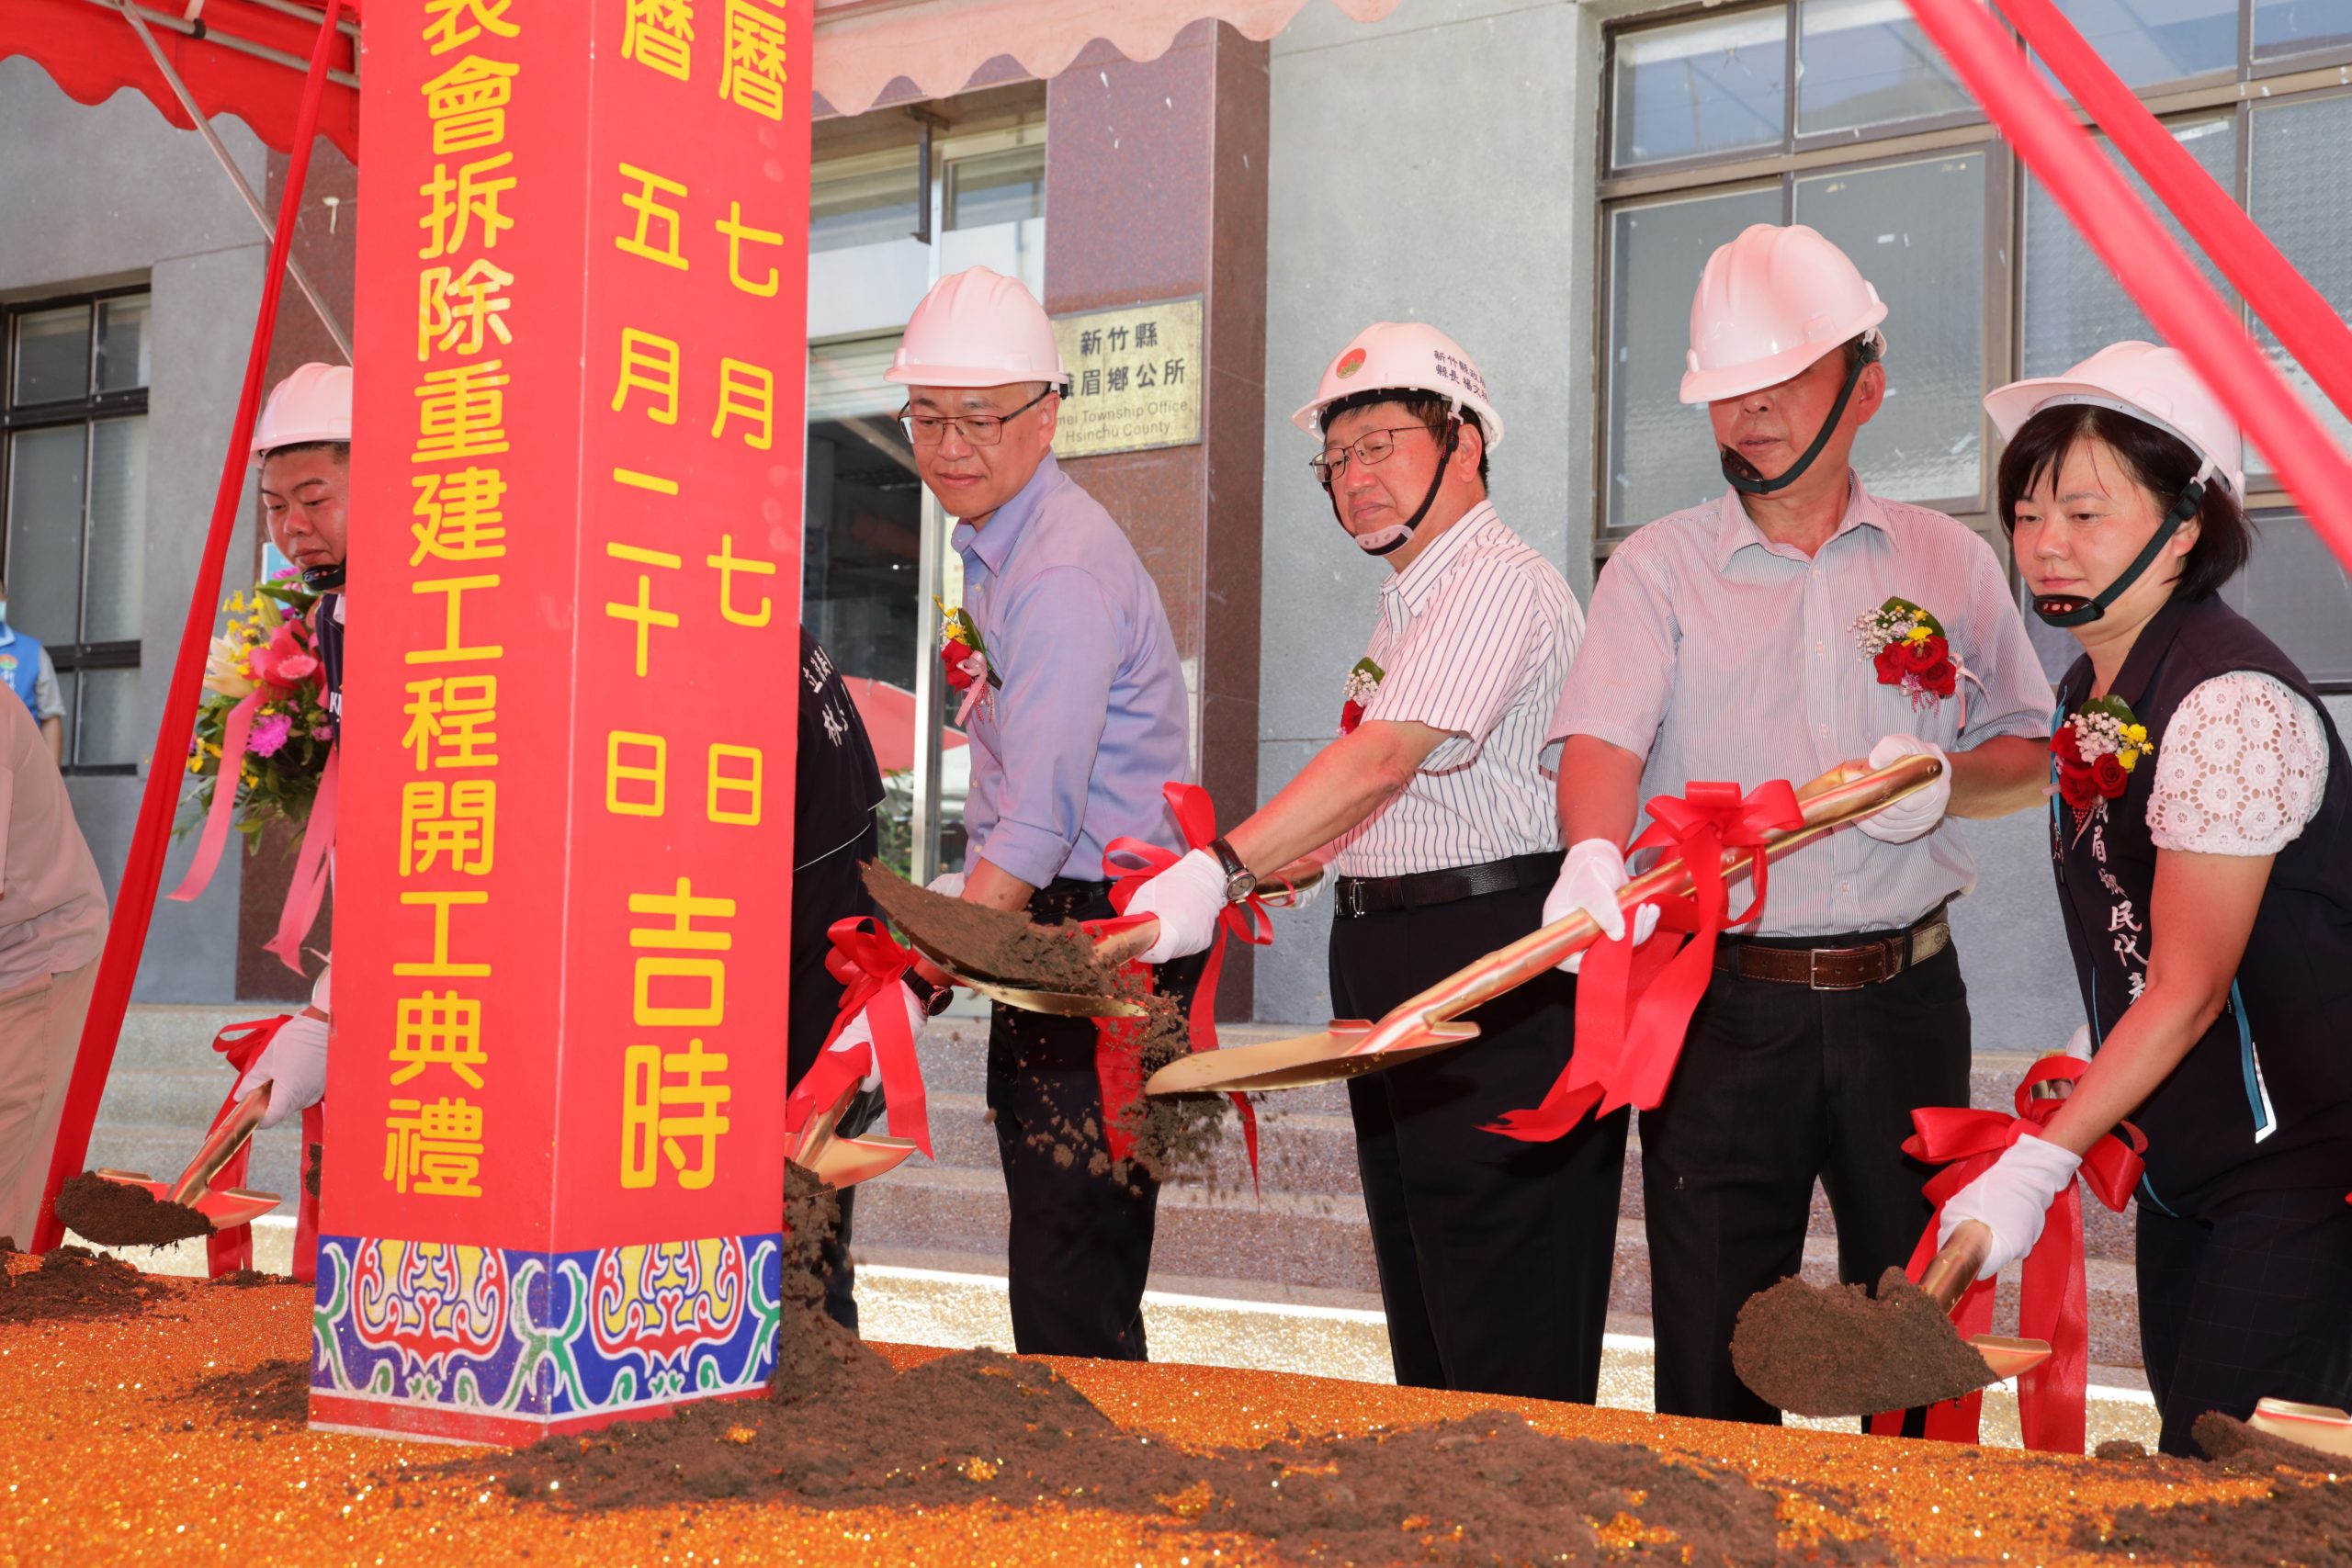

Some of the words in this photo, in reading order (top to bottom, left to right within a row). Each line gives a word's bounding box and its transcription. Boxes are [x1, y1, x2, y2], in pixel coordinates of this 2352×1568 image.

[1080, 321, 1159, 357] 新竹縣
[1057, 406, 1078, 426] mei
[1082, 406, 1145, 423] Township
[1065, 423, 1120, 444] Hsinchu
[1123, 420, 1171, 438] County
[619, 875, 737, 1190] 吉時
